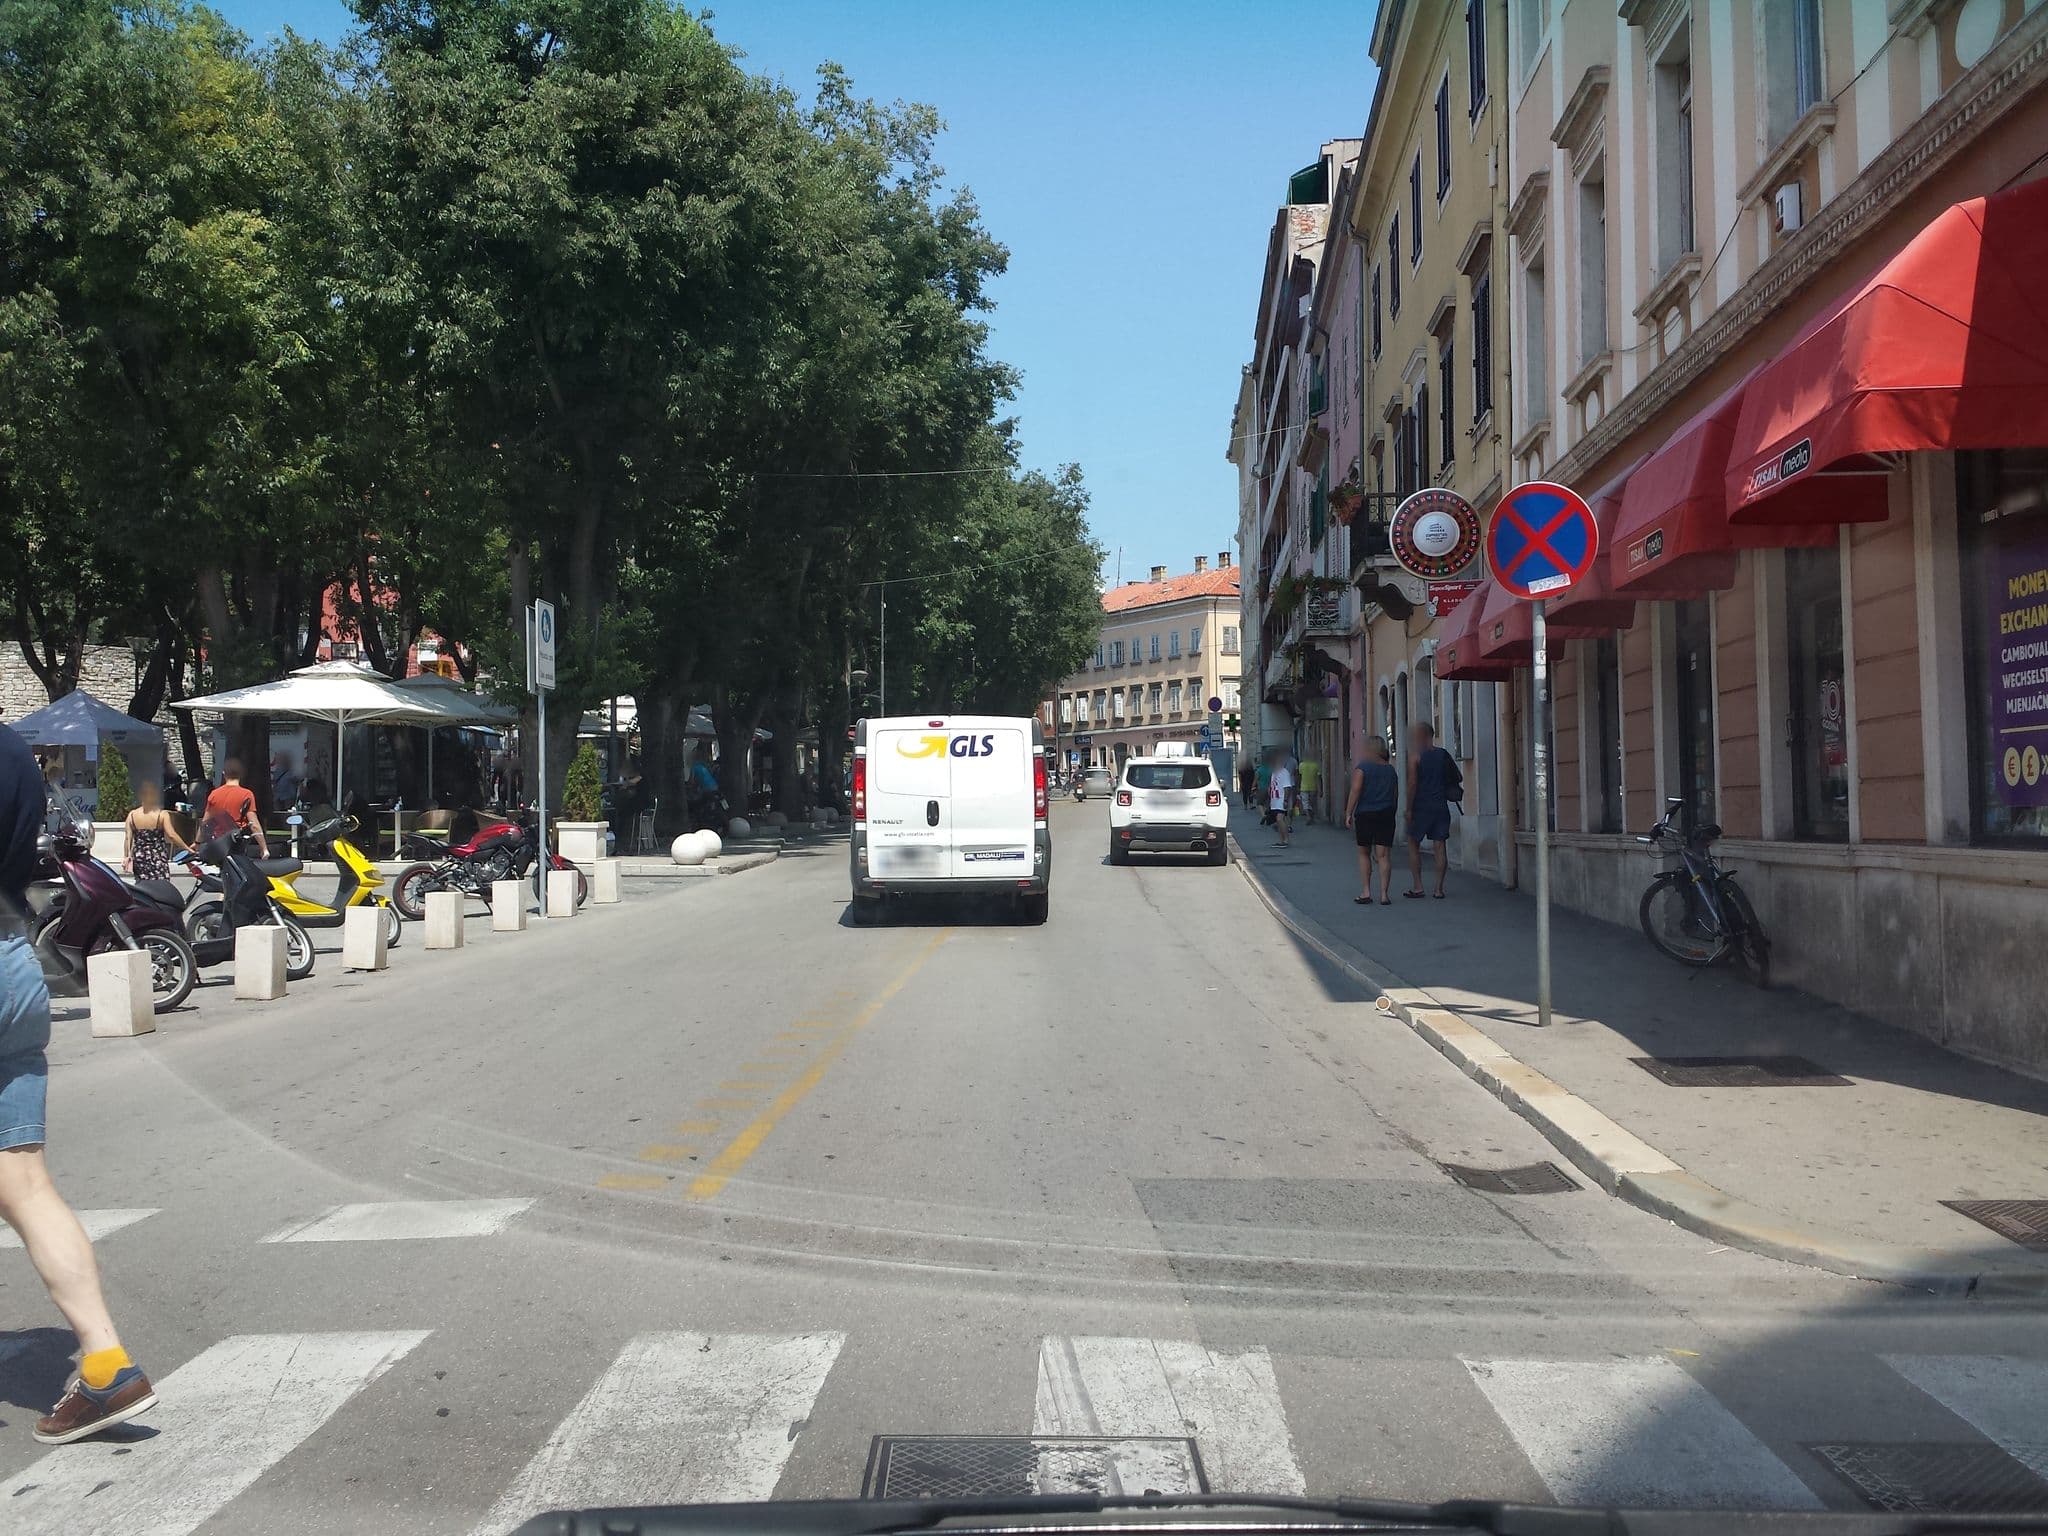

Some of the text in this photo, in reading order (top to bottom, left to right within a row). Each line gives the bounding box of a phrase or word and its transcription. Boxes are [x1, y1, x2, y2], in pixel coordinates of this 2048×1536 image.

[1783, 448, 1808, 475] media
[2000, 604, 2048, 634] EXCHAN
[2001, 640, 2048, 664] CAMBIOVAL
[2002, 667, 2048, 689] WECHSELST
[949, 735, 994, 758] GLS
